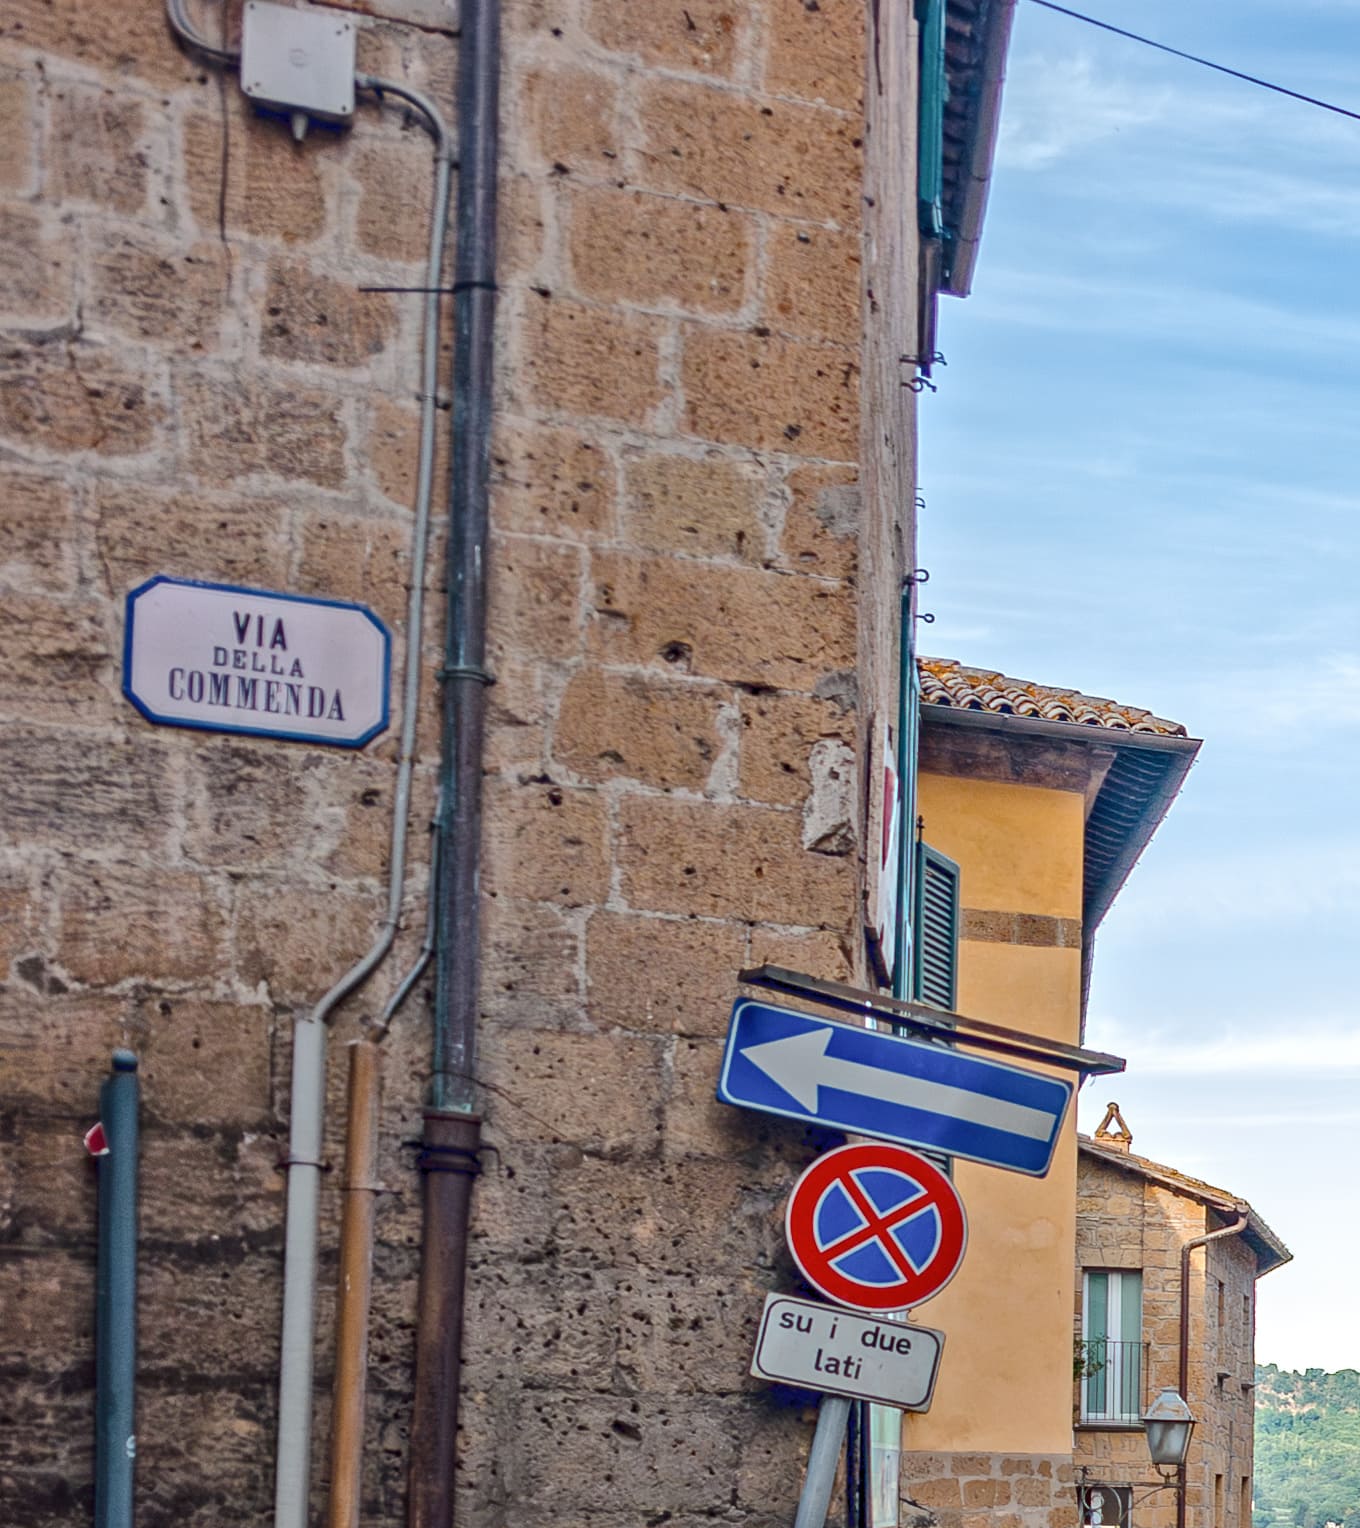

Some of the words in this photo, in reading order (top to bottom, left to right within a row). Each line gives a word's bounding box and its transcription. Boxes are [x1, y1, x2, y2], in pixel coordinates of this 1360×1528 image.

[233, 611, 287, 651] VIA
[213, 646, 305, 679] DELLA
[168, 667, 346, 722] COMMENDA
[779, 1310, 811, 1335] su
[830, 1316, 838, 1340] i
[861, 1325, 911, 1357] due
[814, 1348, 863, 1381] lati
